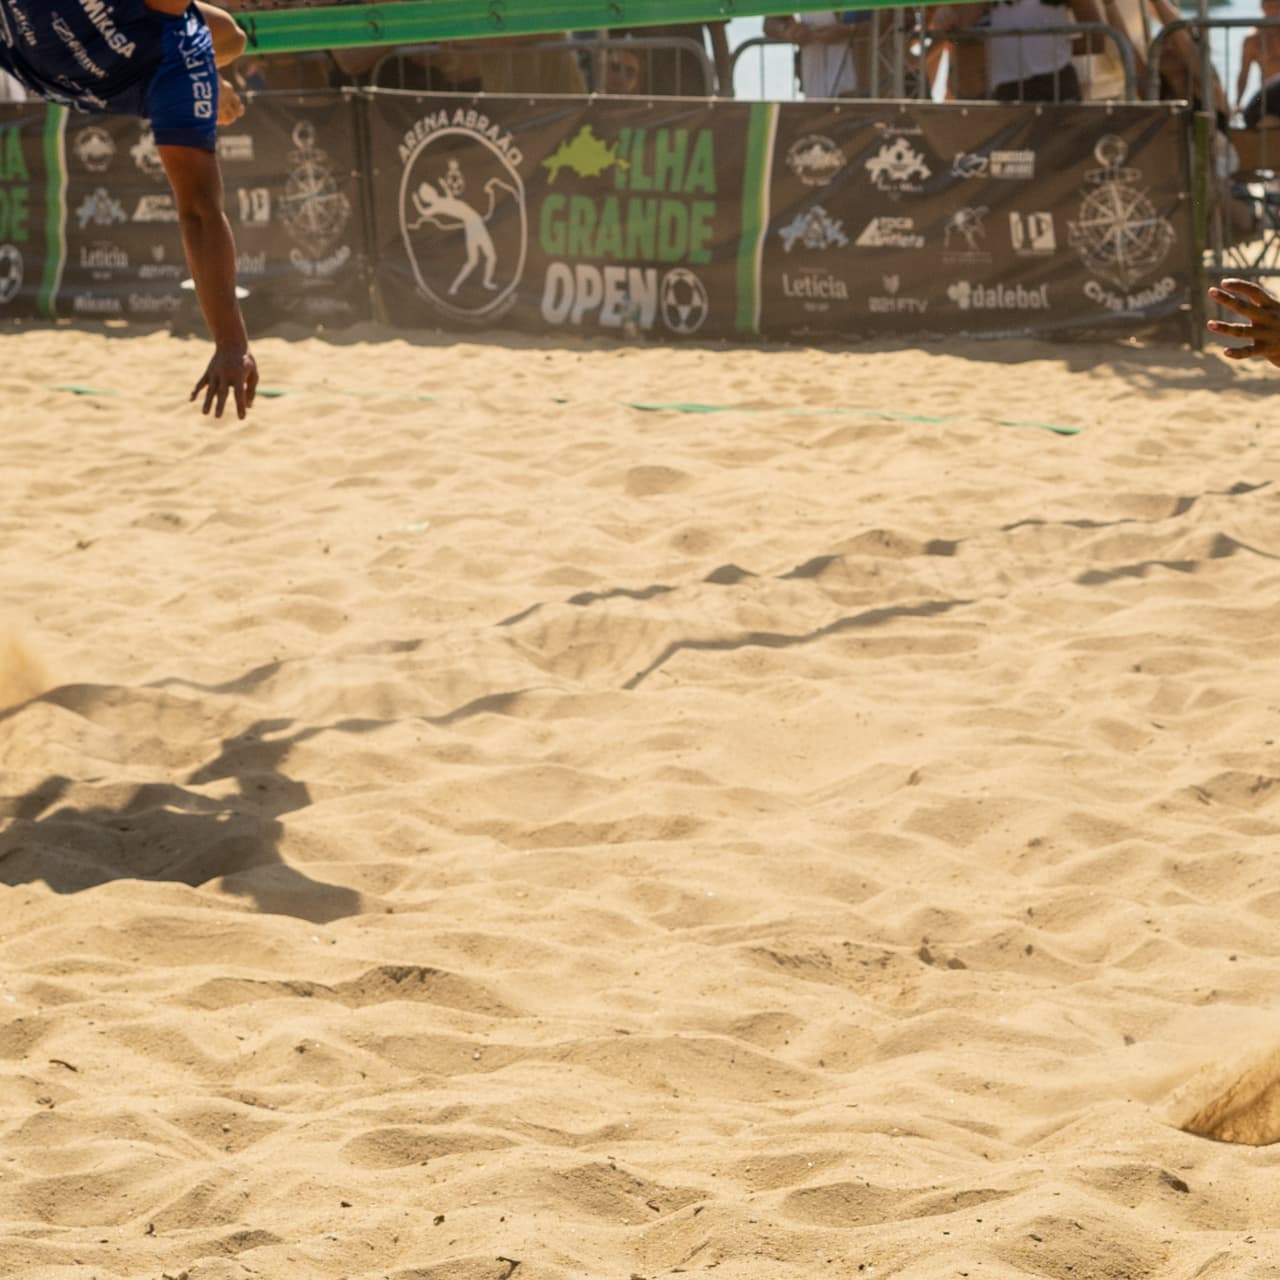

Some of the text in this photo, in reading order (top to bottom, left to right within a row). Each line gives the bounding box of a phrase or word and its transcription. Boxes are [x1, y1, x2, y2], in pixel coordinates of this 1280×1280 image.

[397, 107, 525, 168] ARENA ABRAÃO
[614, 126, 718, 194] ILHA
[540, 193, 717, 265] GRANDE
[541, 261, 660, 331] OPEN
[972, 282, 1052, 310] dalebol
